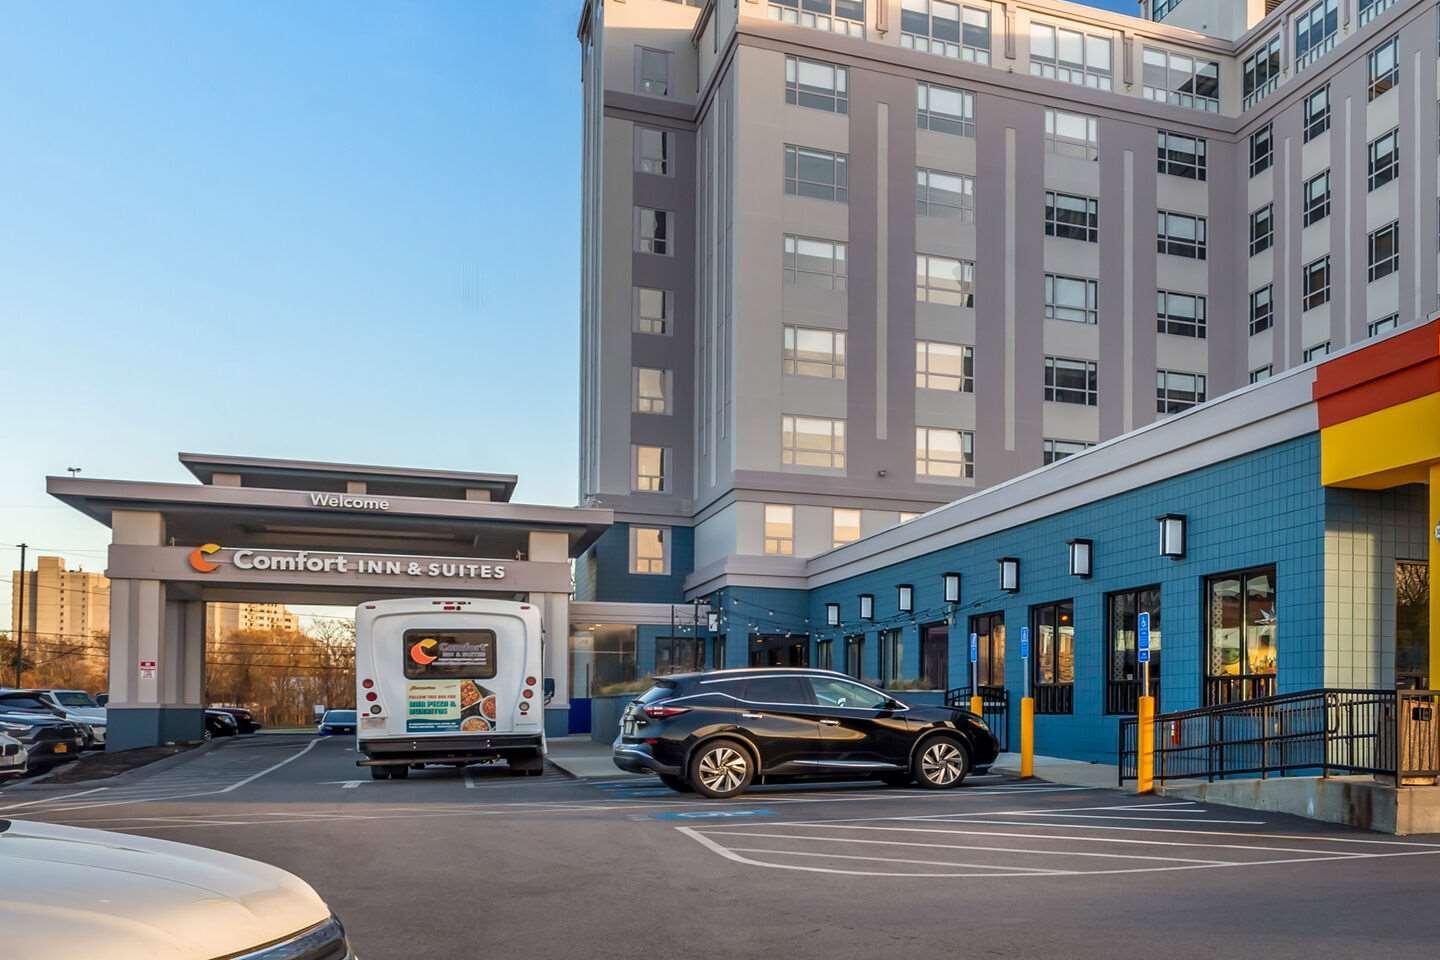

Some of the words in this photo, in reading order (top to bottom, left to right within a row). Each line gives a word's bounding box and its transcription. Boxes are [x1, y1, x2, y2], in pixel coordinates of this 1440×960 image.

[309, 493, 390, 510] Welcome
[233, 549, 347, 573] Comfort
[358, 559, 401, 575] INN
[407, 562, 422, 576] &
[428, 563, 505, 579] SUITES
